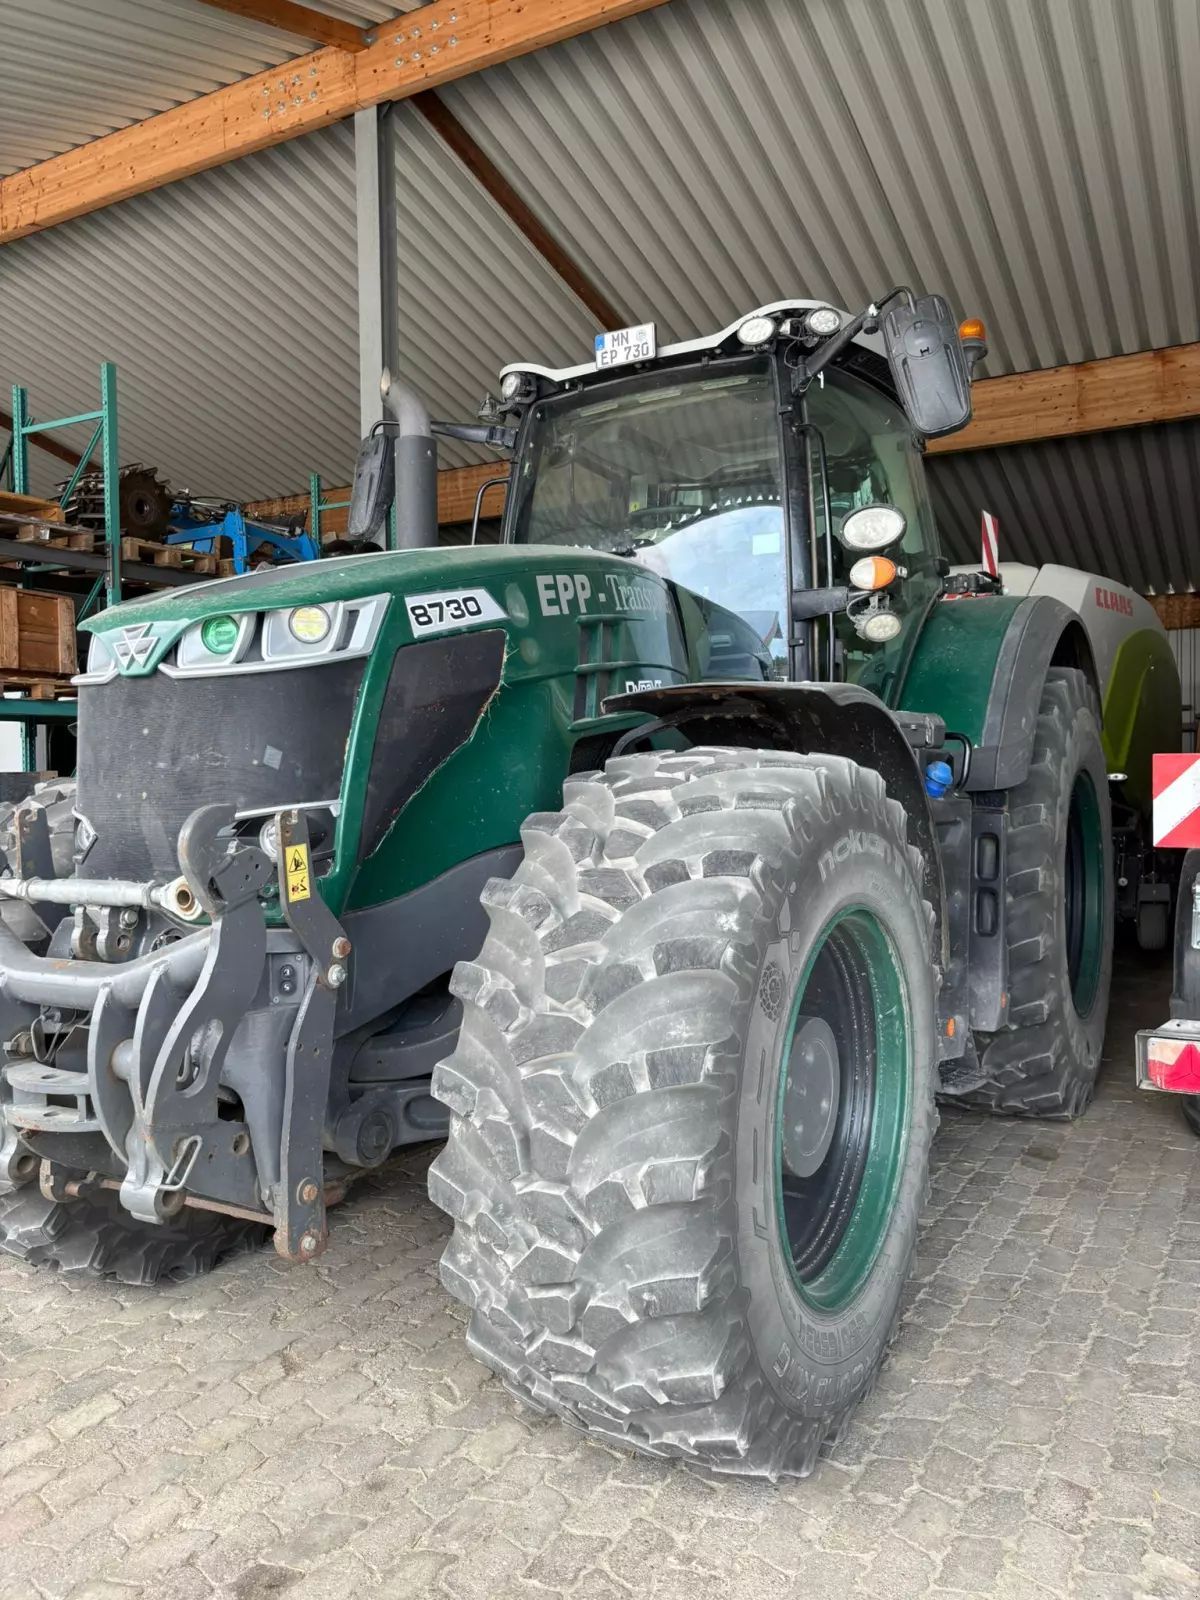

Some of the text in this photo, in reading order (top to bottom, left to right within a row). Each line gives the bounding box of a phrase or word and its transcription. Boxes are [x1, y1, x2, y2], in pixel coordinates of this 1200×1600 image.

[600, 342, 649, 366] EP 730
[611, 331, 629, 348] MN
[535, 574, 592, 617] EPP
[1095, 587, 1134, 617] CLAAS
[409, 596, 483, 626] 8730
